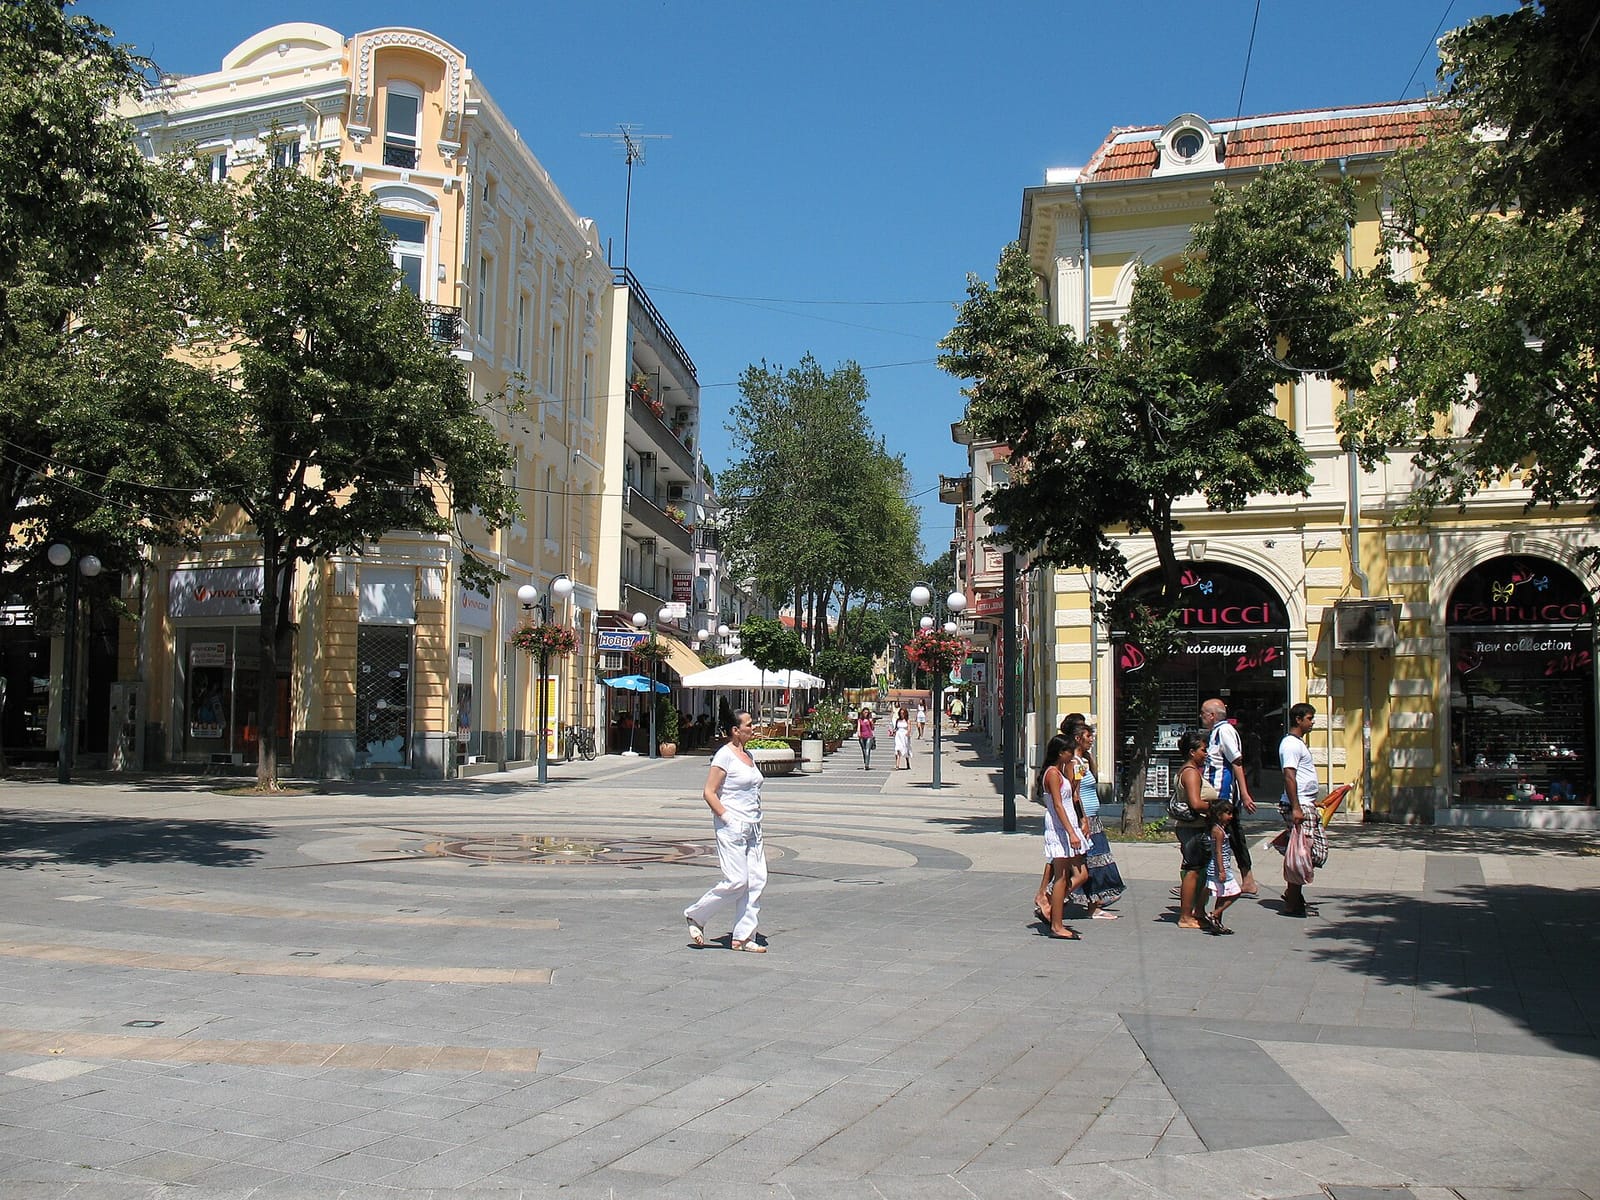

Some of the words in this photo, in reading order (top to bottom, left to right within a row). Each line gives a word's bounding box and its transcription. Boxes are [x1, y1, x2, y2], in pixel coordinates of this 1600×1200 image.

[599, 635, 636, 648] HOBBY
[1476, 641, 1501, 652] new
[1504, 636, 1573, 653] collection
[1186, 644, 1248, 656] колекция
[1545, 650, 1593, 676] 2012
